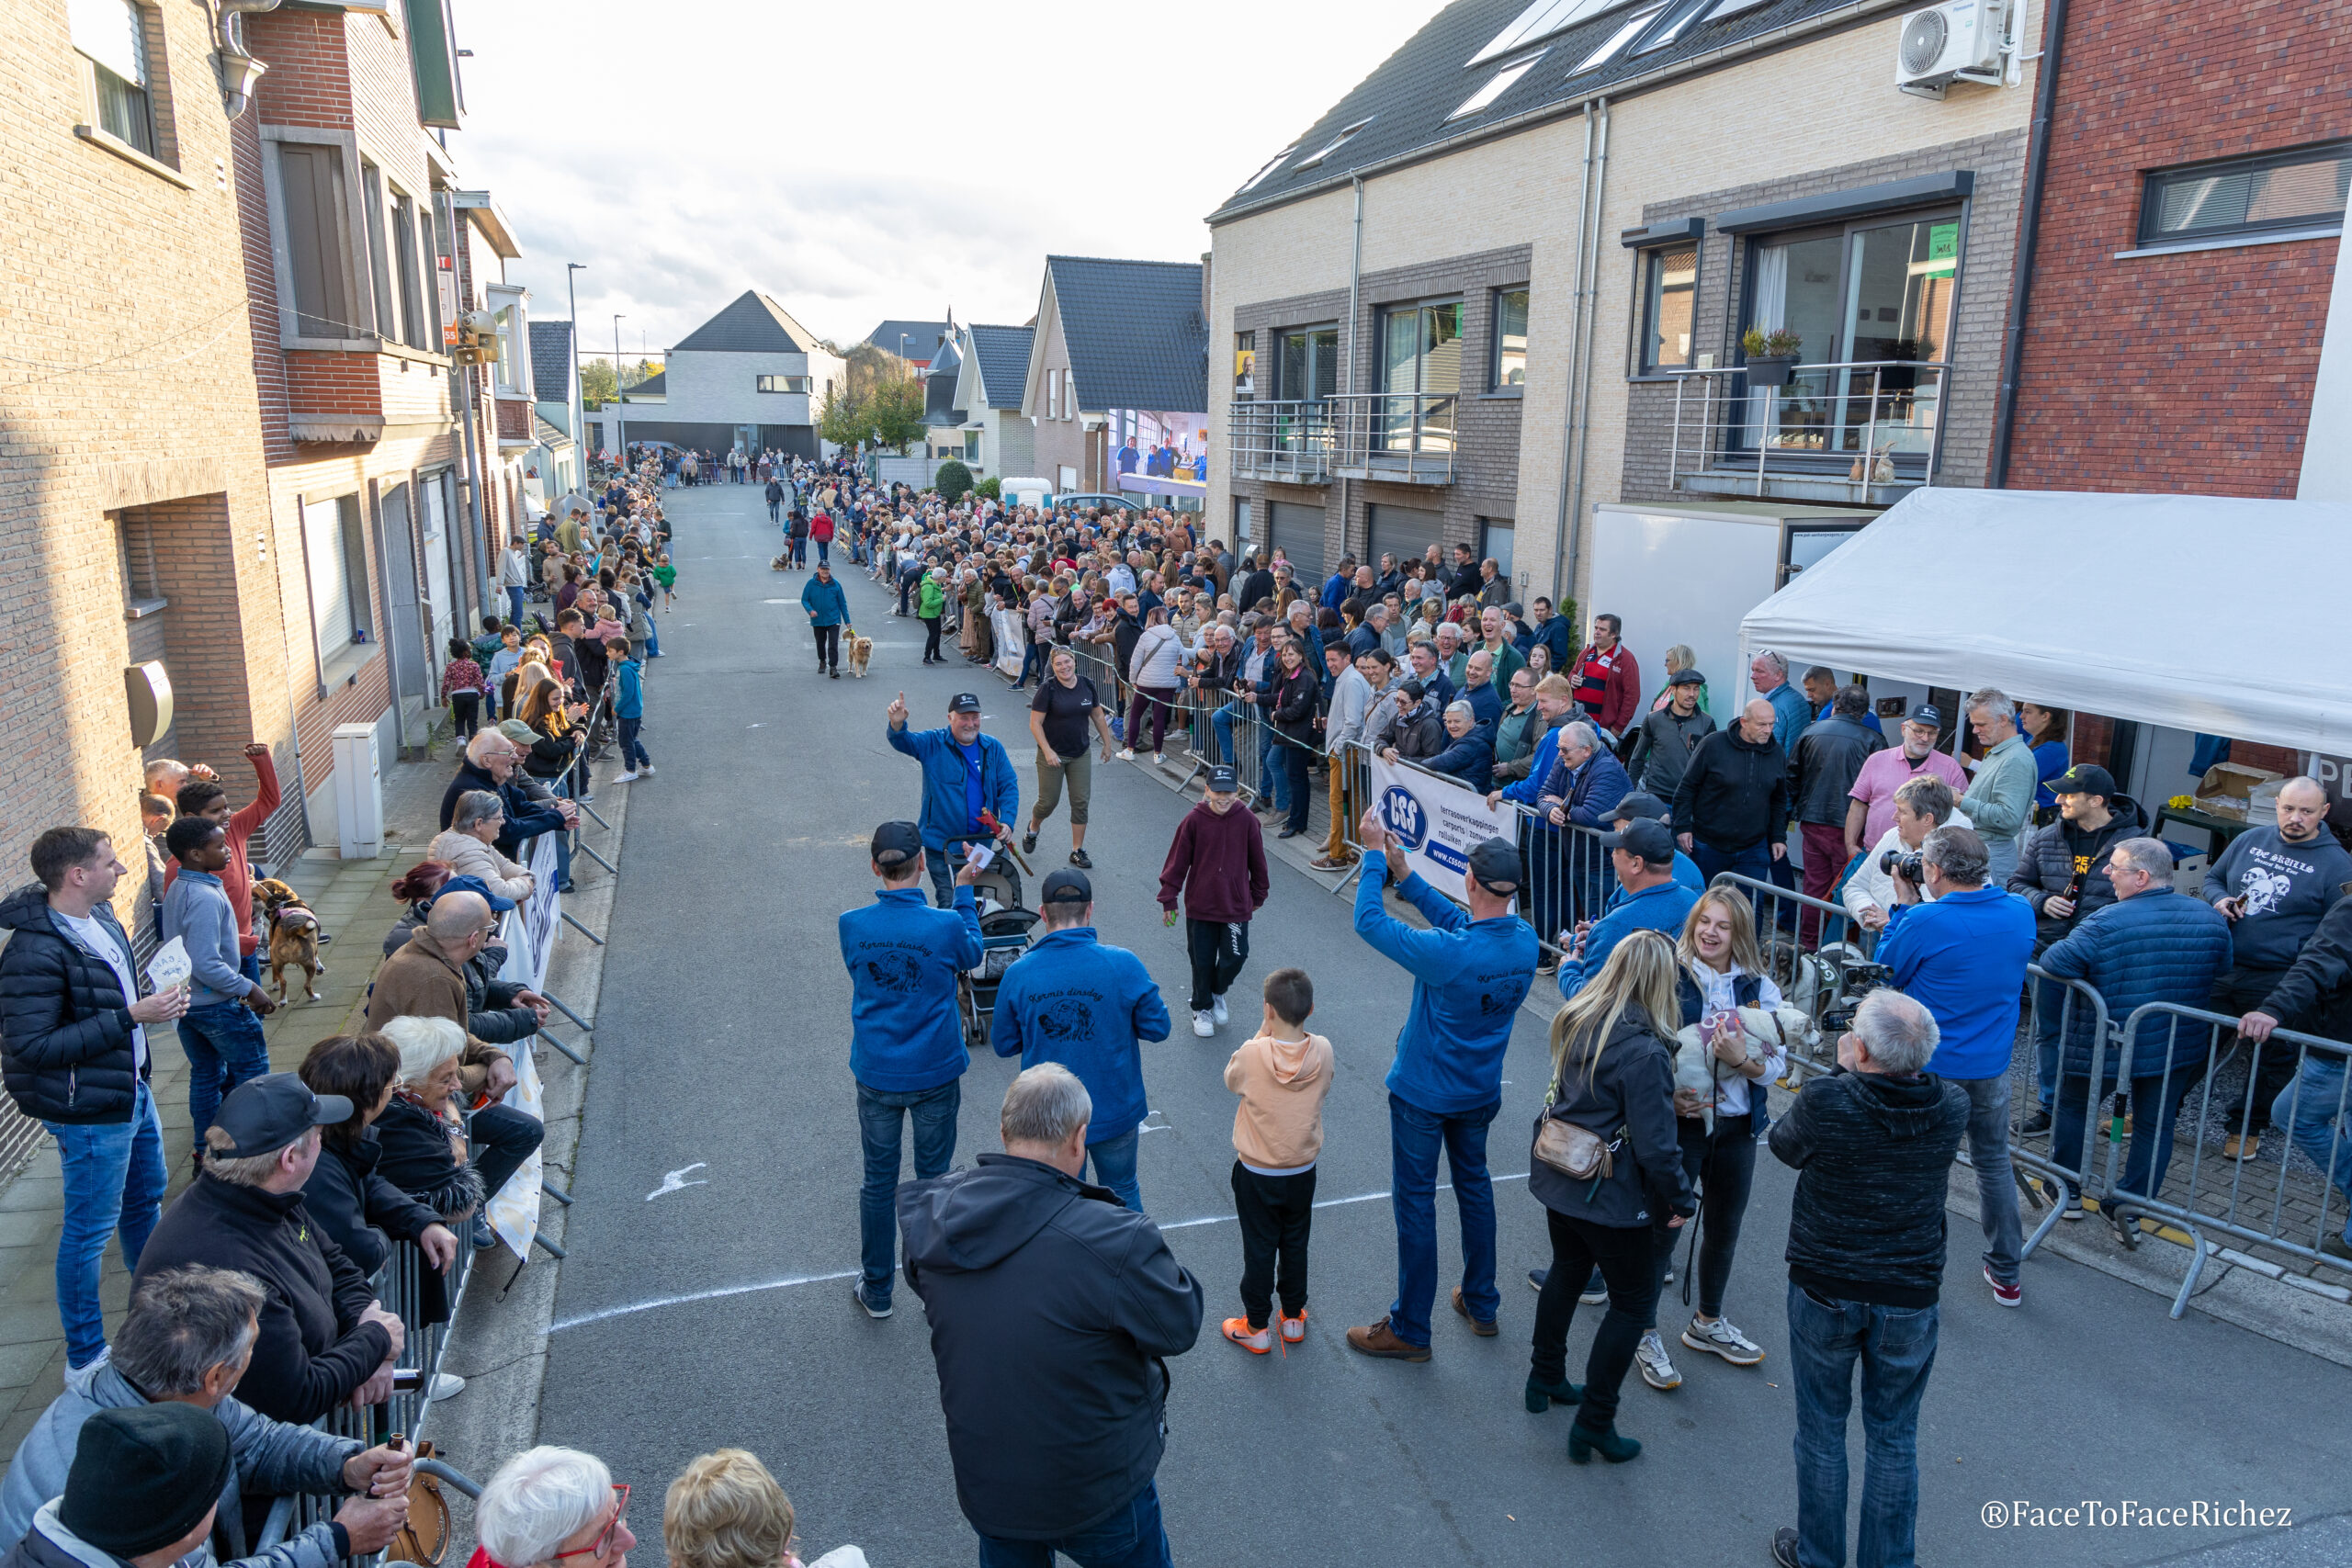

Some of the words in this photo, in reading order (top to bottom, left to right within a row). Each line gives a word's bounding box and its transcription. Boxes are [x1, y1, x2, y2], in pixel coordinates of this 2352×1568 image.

[1390, 792, 1418, 835] CSS
[1440, 805, 1499, 834] terrasoverkappingen
[1438, 830, 1462, 846] rolluiken
[1442, 819, 1465, 835] carports
[1433, 849, 1467, 871] www.cssout
